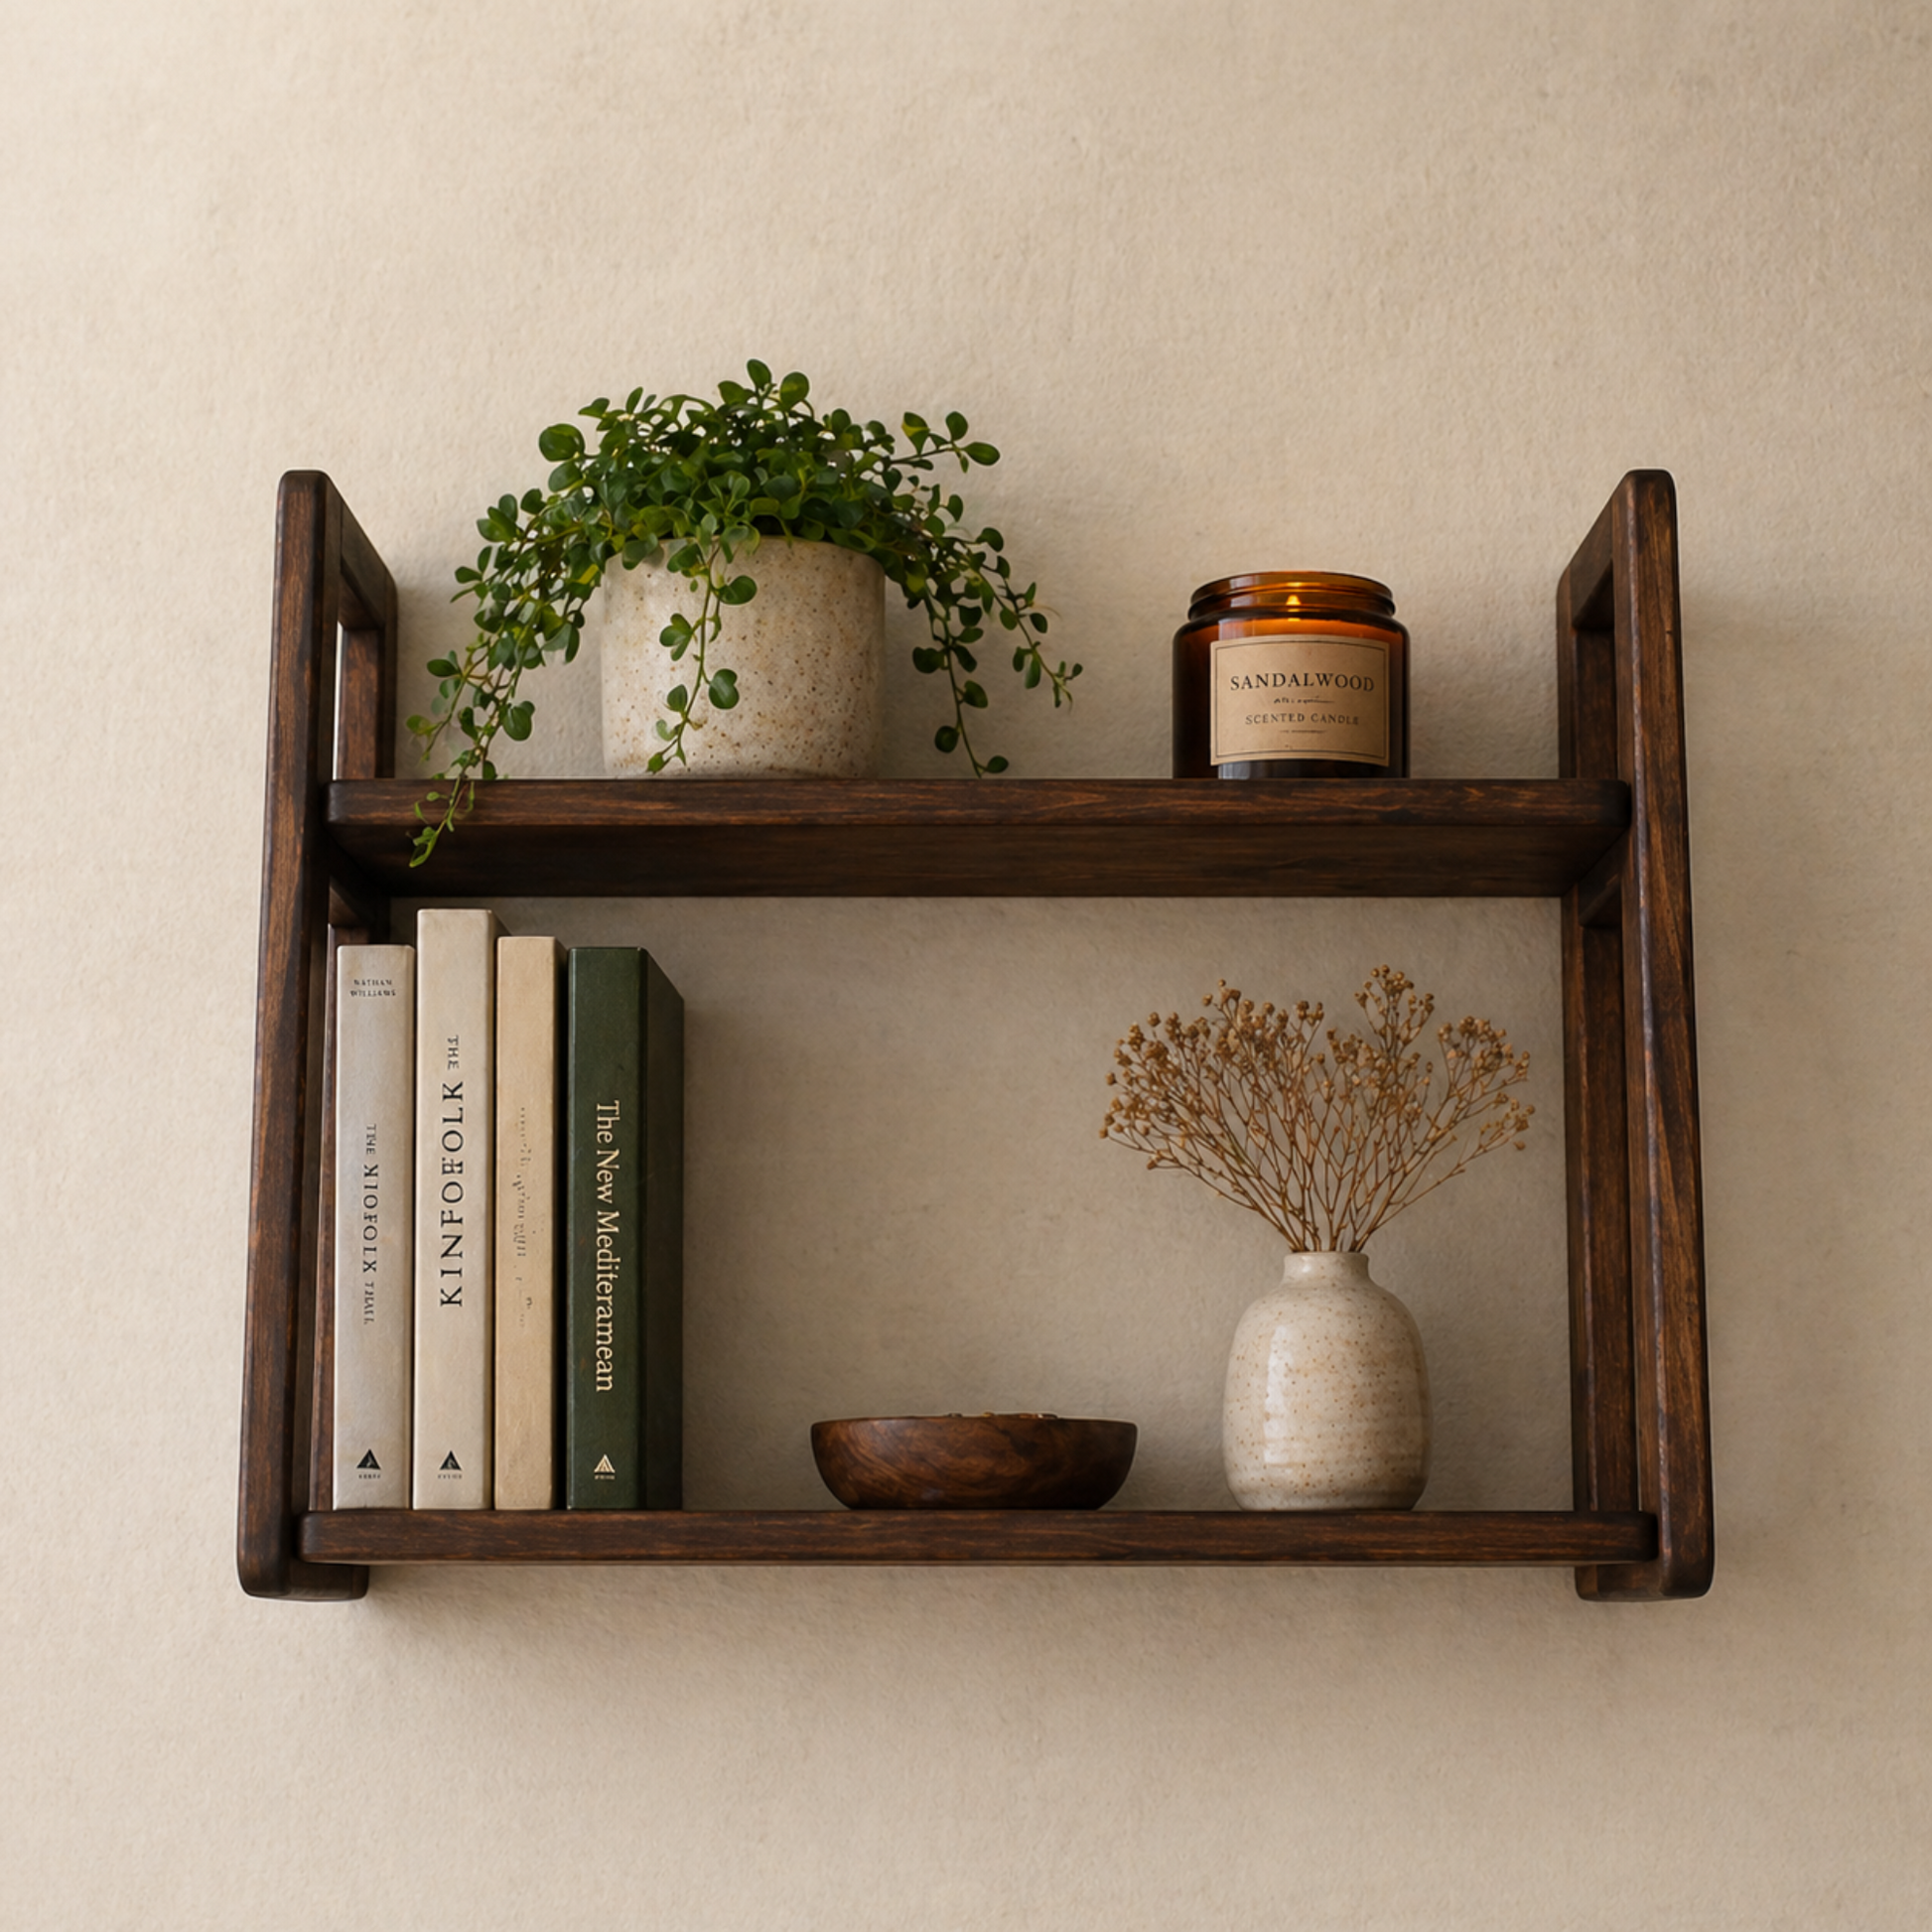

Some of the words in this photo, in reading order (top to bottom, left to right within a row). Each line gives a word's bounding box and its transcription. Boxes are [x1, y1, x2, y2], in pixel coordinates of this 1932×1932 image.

[1230, 672, 1375, 692] SANDALWOOD
[1245, 713, 1306, 726] SCENTED
[1311, 713, 1359, 726] CANDLE
[447, 1035, 460, 1070] THE
[597, 1099, 621, 1144] The
[597, 1149, 621, 1203] New
